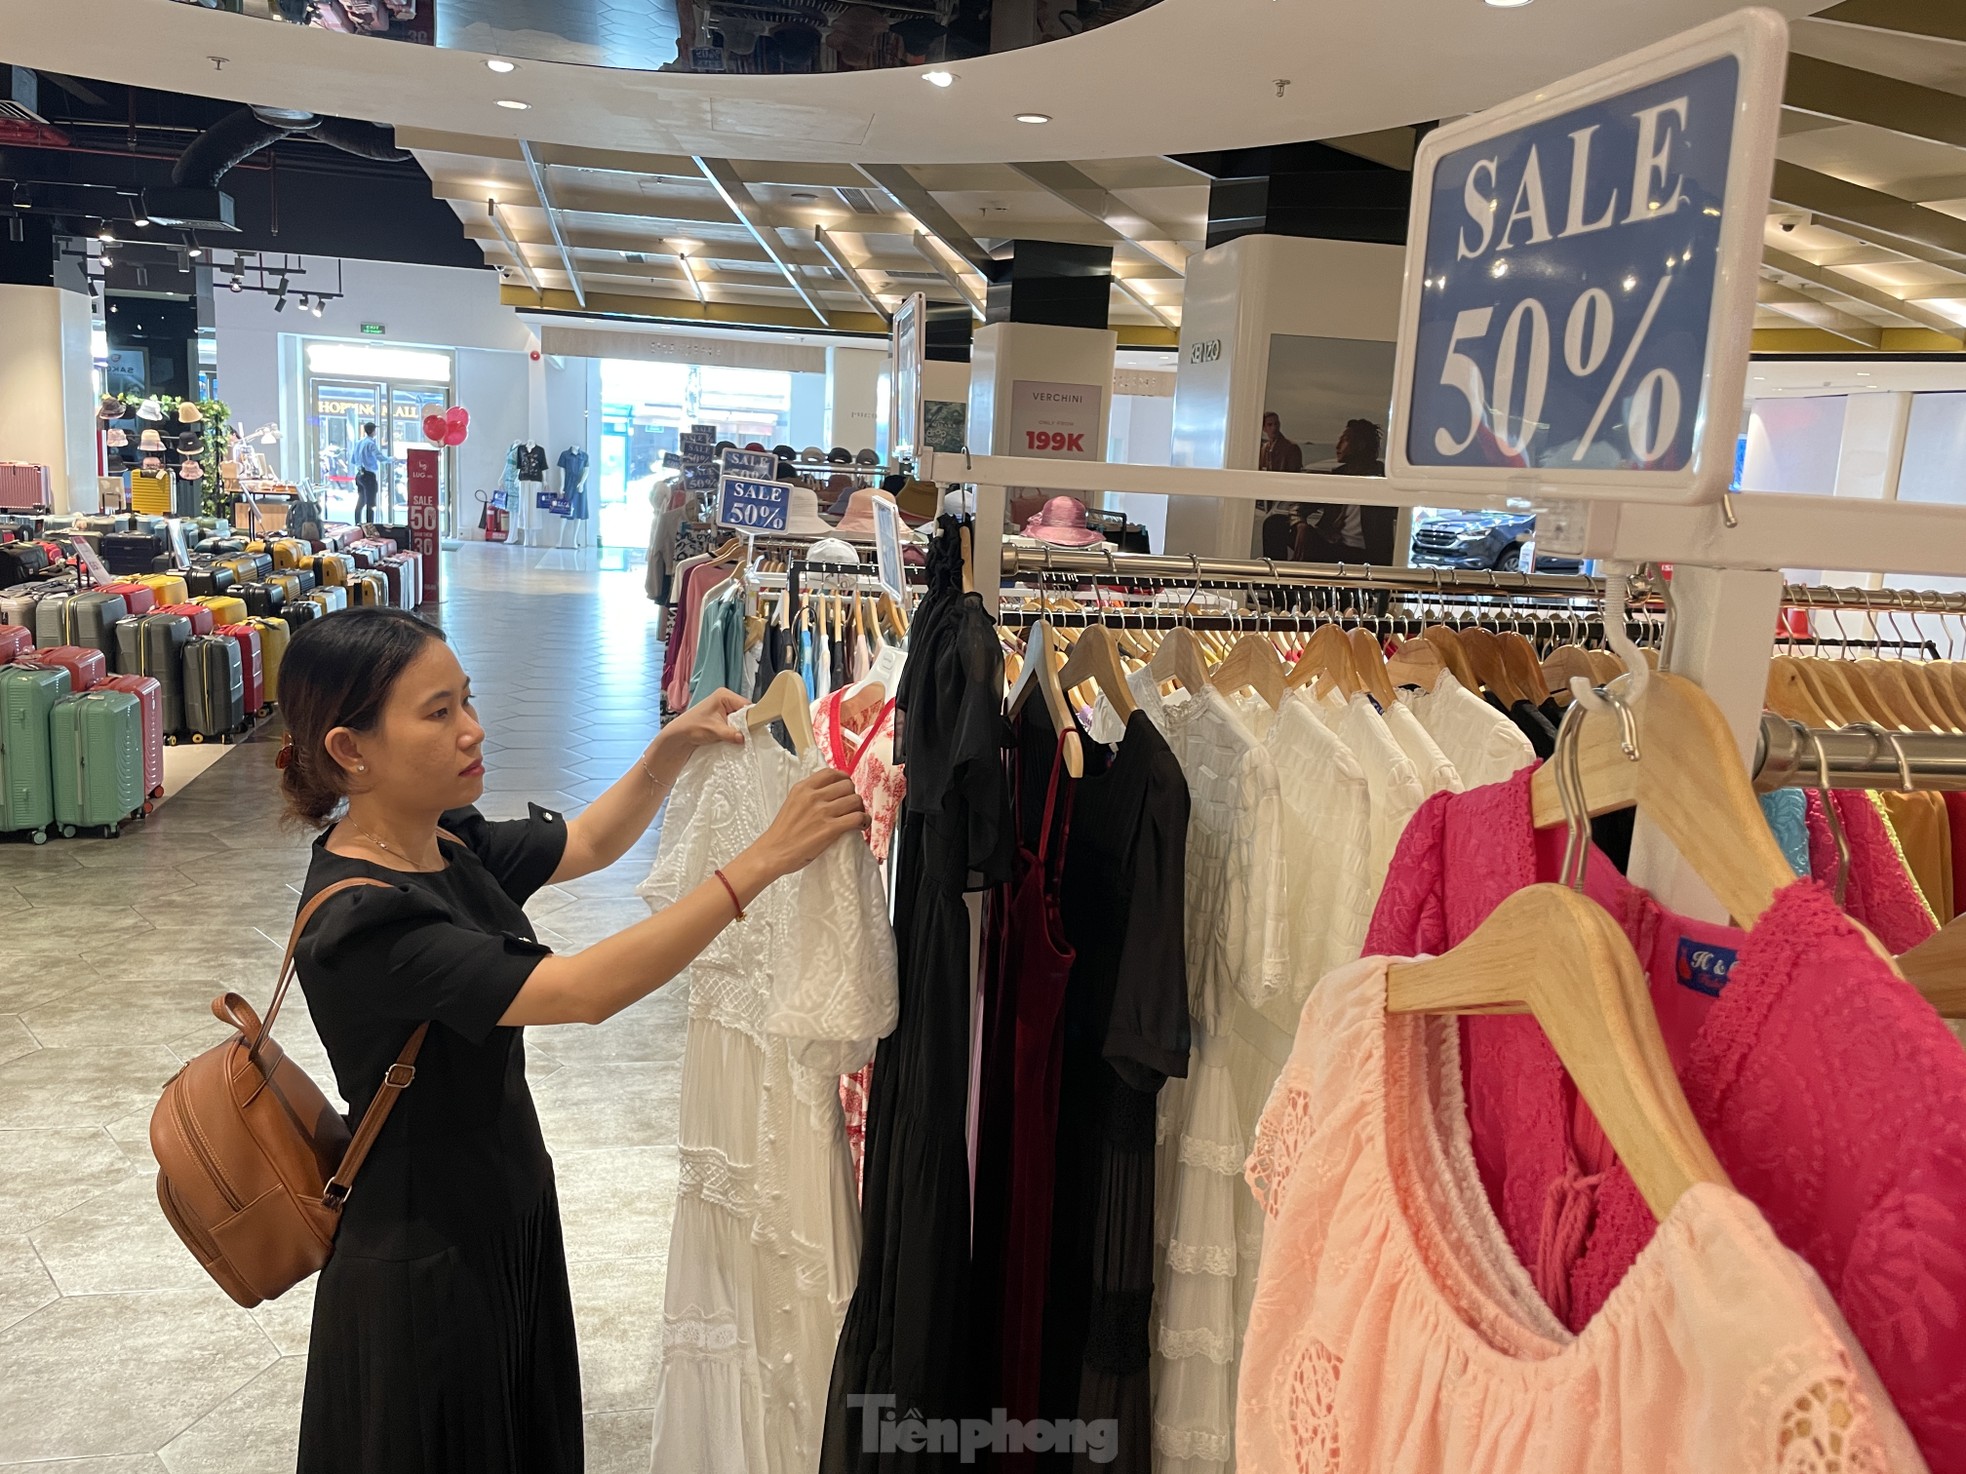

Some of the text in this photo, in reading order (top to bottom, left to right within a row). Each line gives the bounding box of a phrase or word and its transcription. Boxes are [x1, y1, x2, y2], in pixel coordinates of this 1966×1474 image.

[1456, 96, 1690, 262] SALE
[1190, 339, 1222, 364] KENZO
[1434, 275, 1682, 463] 50%
[1032, 392, 1083, 403] VERCHINI
[318, 401, 375, 416] HOPPING
[1025, 430, 1085, 452] 199K
[730, 453, 768, 468] SALE
[413, 495, 433, 506] SALE
[733, 482, 782, 502] SALE
[410, 506, 437, 530] 50
[730, 502, 784, 529] 50%
[414, 538, 433, 556] 30
[1713, 959, 1726, 975] &
